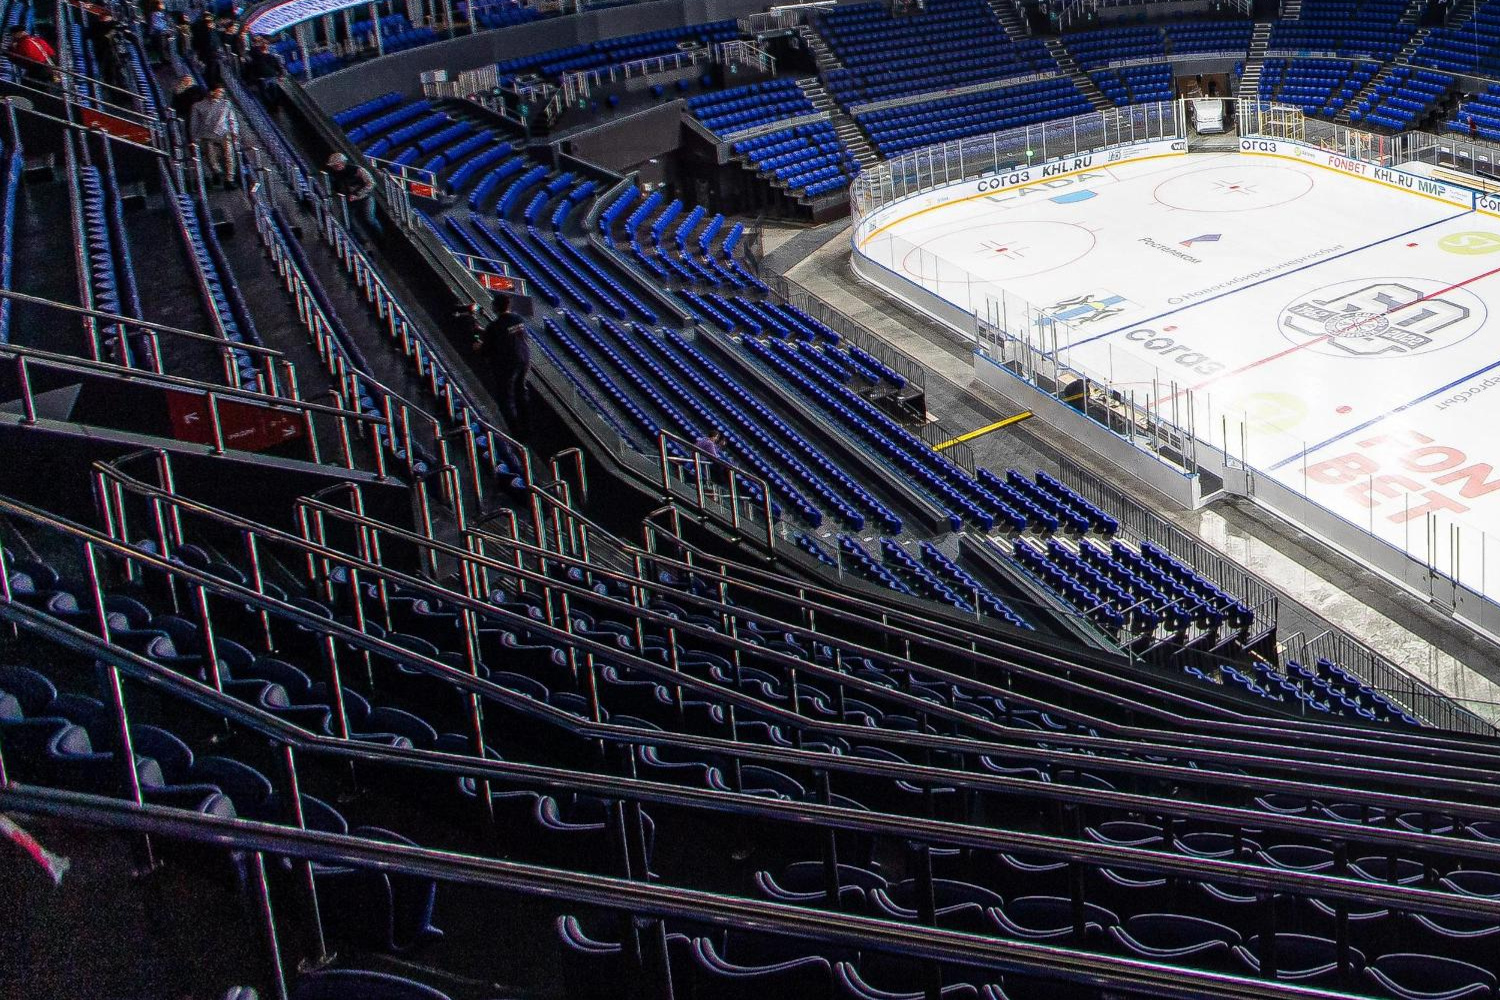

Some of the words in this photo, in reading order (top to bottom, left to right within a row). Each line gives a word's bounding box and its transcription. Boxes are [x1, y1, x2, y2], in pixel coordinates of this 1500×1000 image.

[1042, 155, 1093, 178] KHL.RU
[1327, 155, 1367, 174] FONBET
[983, 171, 1104, 203] LADA
[1374, 167, 1413, 189] KHL.RU
[1418, 179, 1446, 197] МИР
